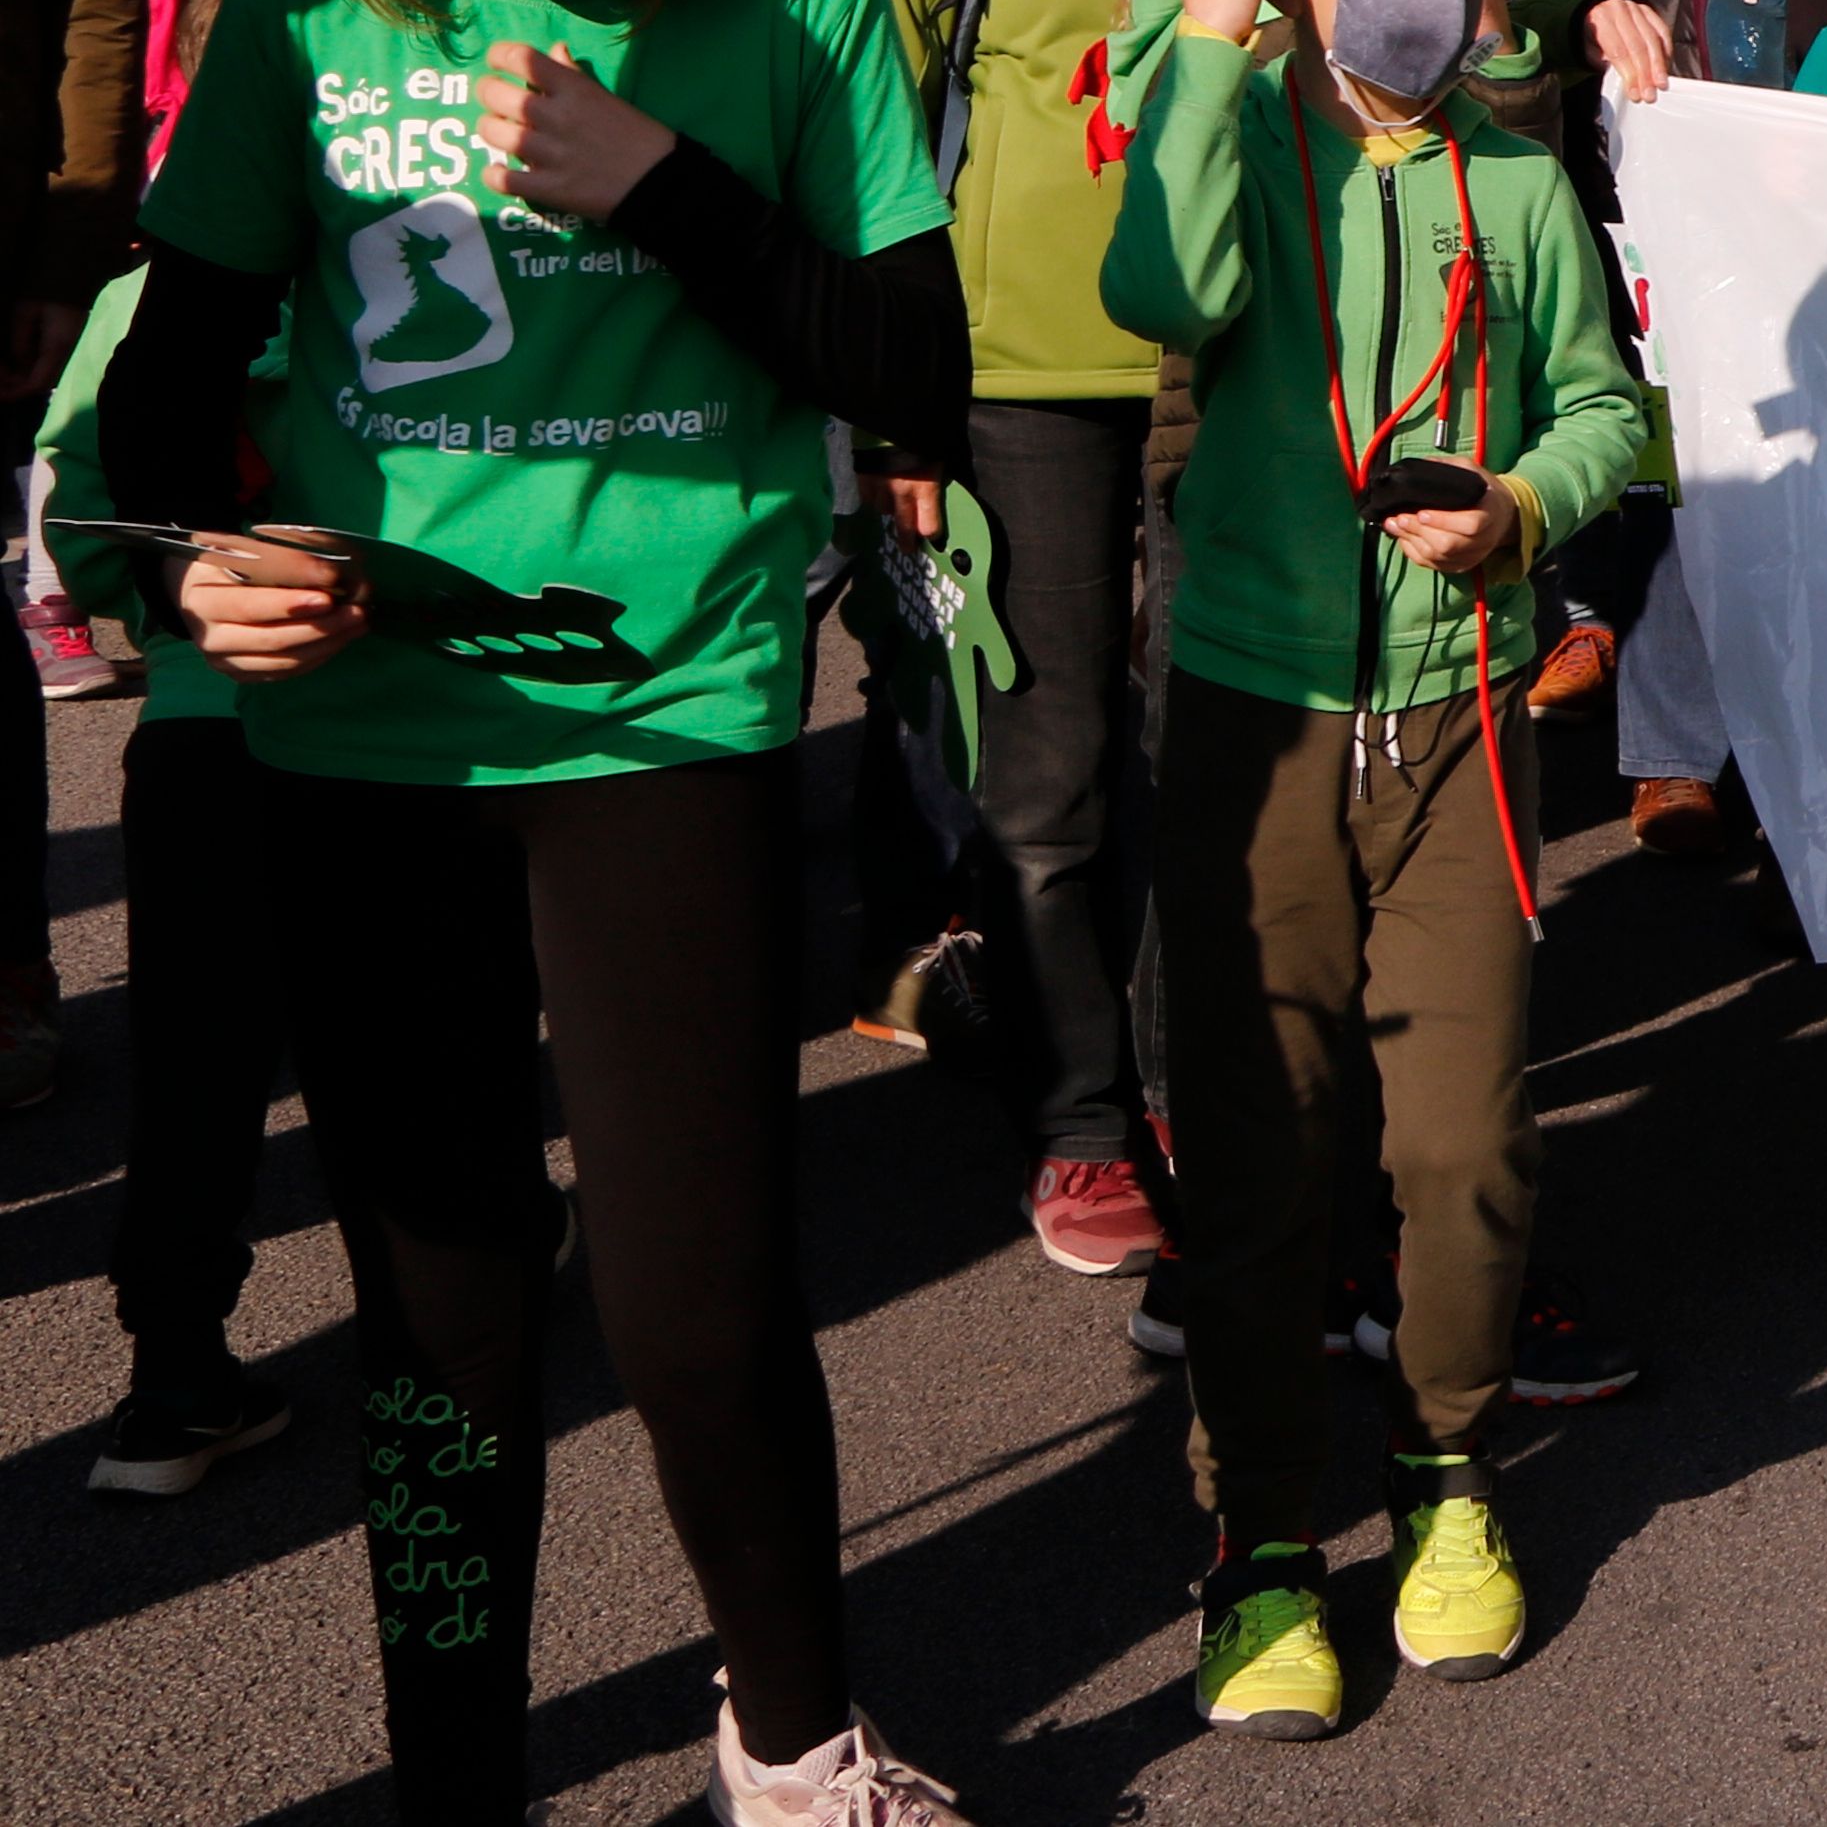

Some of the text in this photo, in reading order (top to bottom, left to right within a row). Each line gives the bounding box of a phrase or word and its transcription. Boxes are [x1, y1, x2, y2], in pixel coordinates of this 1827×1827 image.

[405, 68, 468, 105] en
[528, 416, 614, 447] seva
[941, 573, 966, 611] EN
